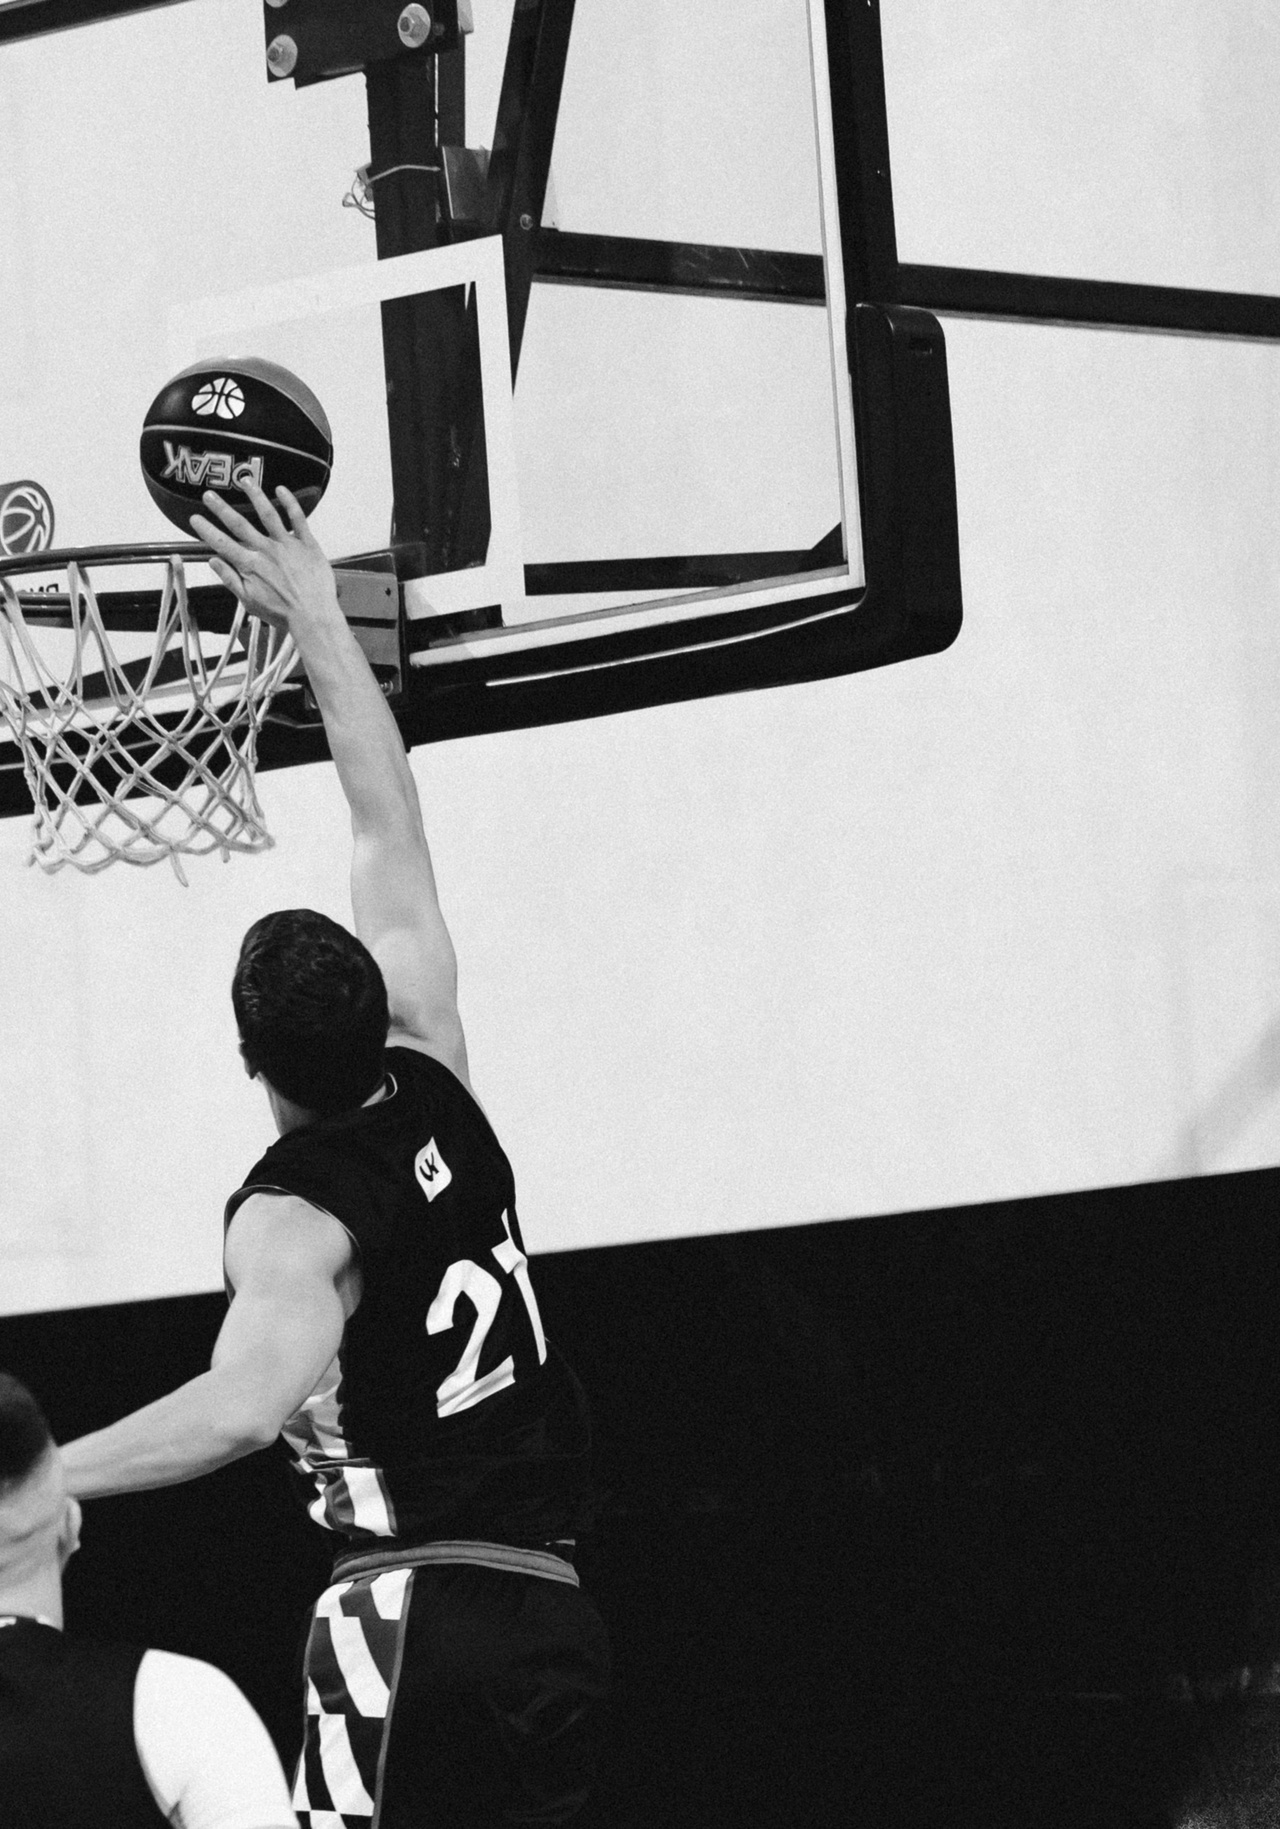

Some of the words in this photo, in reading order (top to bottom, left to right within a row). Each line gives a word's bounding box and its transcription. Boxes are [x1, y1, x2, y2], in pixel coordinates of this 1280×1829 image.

[160, 440, 264, 491] PEAK
[419, 1151, 439, 1182] VK
[426, 1207, 547, 1418] 21
